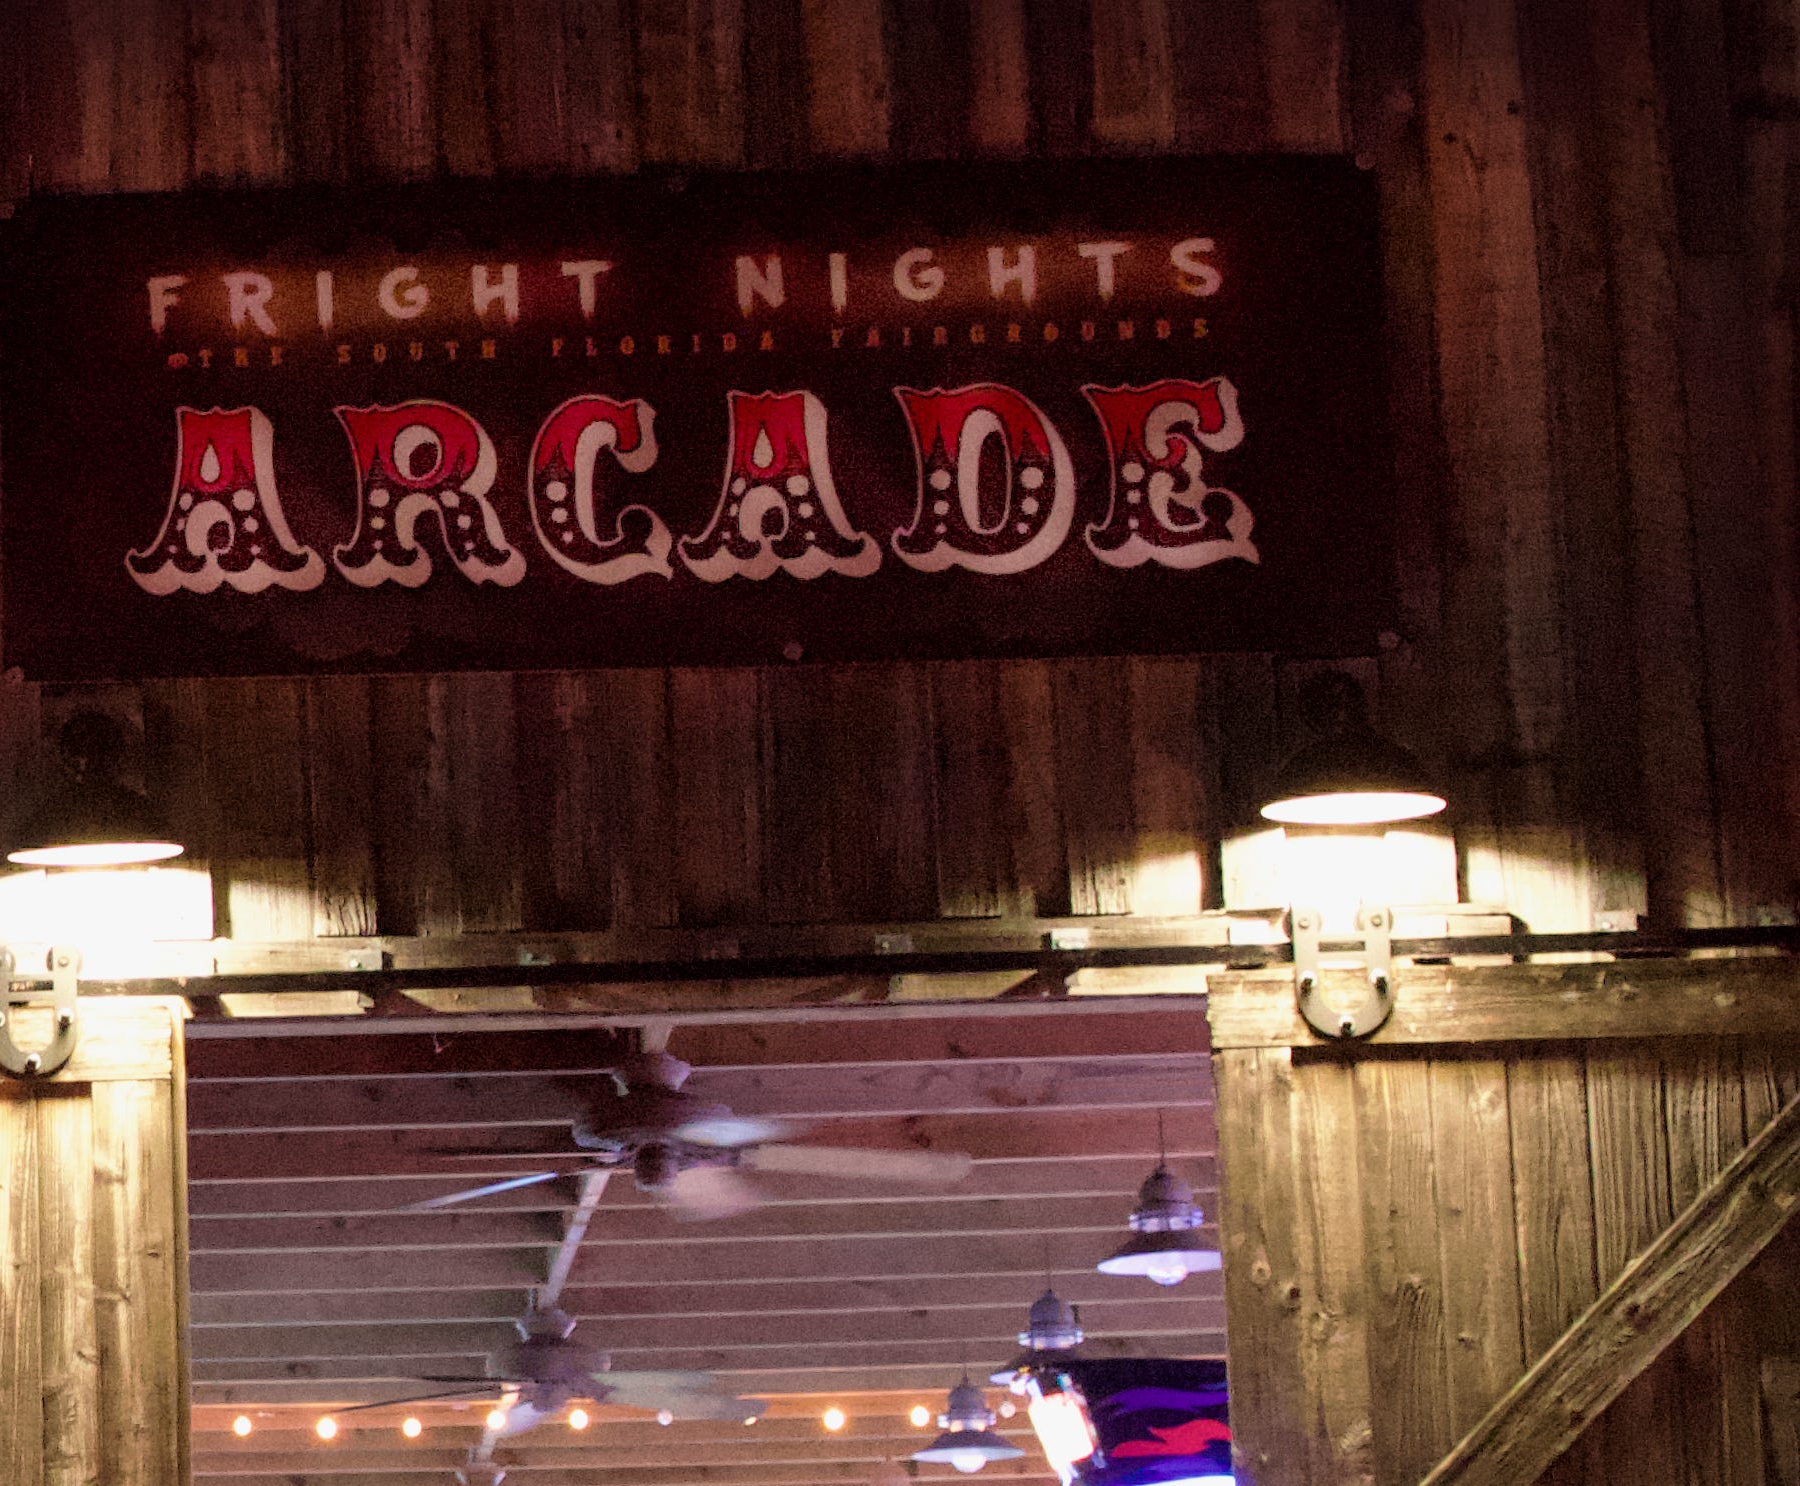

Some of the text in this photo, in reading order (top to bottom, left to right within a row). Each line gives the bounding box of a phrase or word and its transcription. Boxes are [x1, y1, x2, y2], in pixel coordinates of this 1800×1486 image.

[145, 237, 1222, 336] FRIGHT NIGHTS
[337, 337, 497, 366] SOUTH
[551, 331, 776, 359] FLORIDA
[831, 318, 1211, 350] FAIRGROUNDS
[124, 376, 1260, 596] ARCADE
